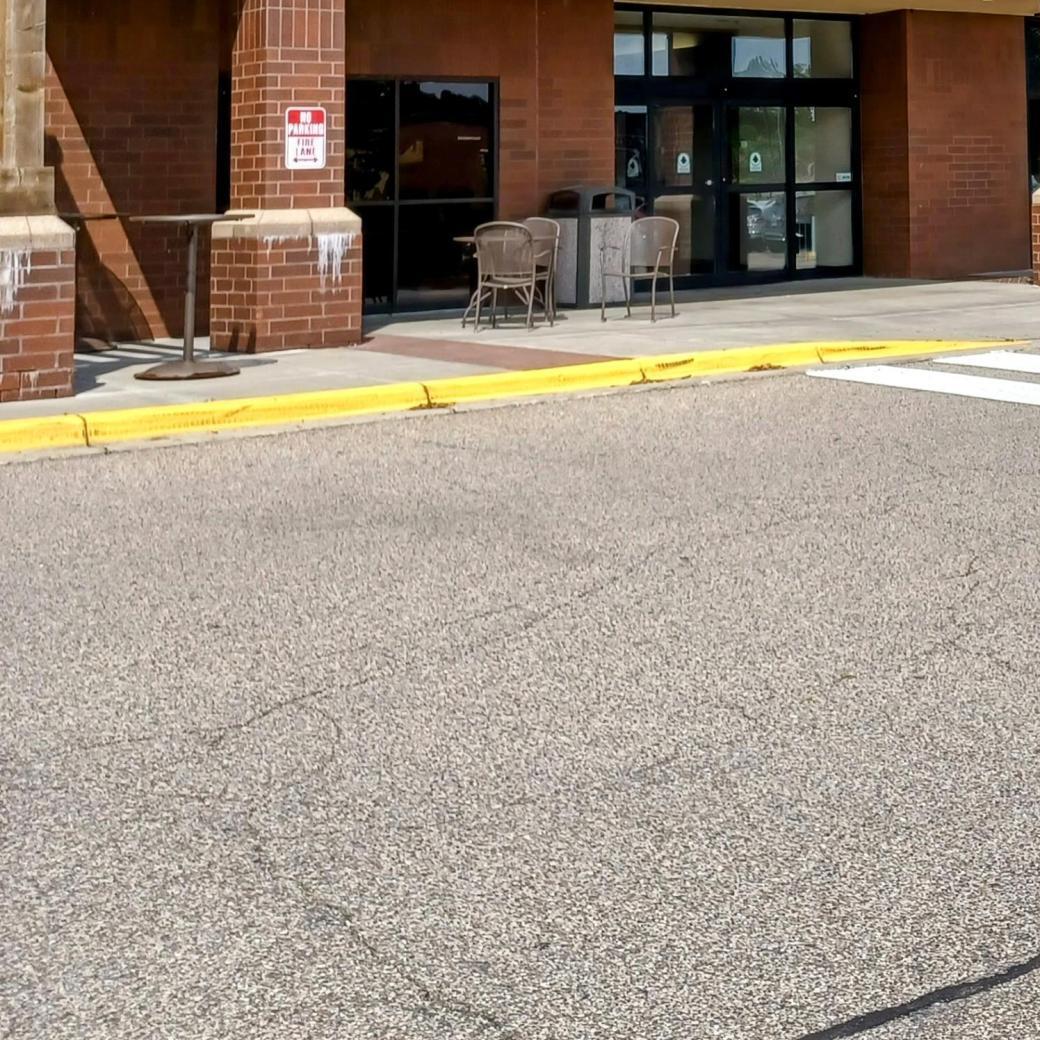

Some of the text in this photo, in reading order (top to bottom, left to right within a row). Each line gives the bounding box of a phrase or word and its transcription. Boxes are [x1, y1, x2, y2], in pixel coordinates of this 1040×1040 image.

[299, 111, 313, 124] NO
[288, 123, 325, 135] PARKING
[297, 138, 314, 146] FIRE
[296, 147, 315, 156] LANE
